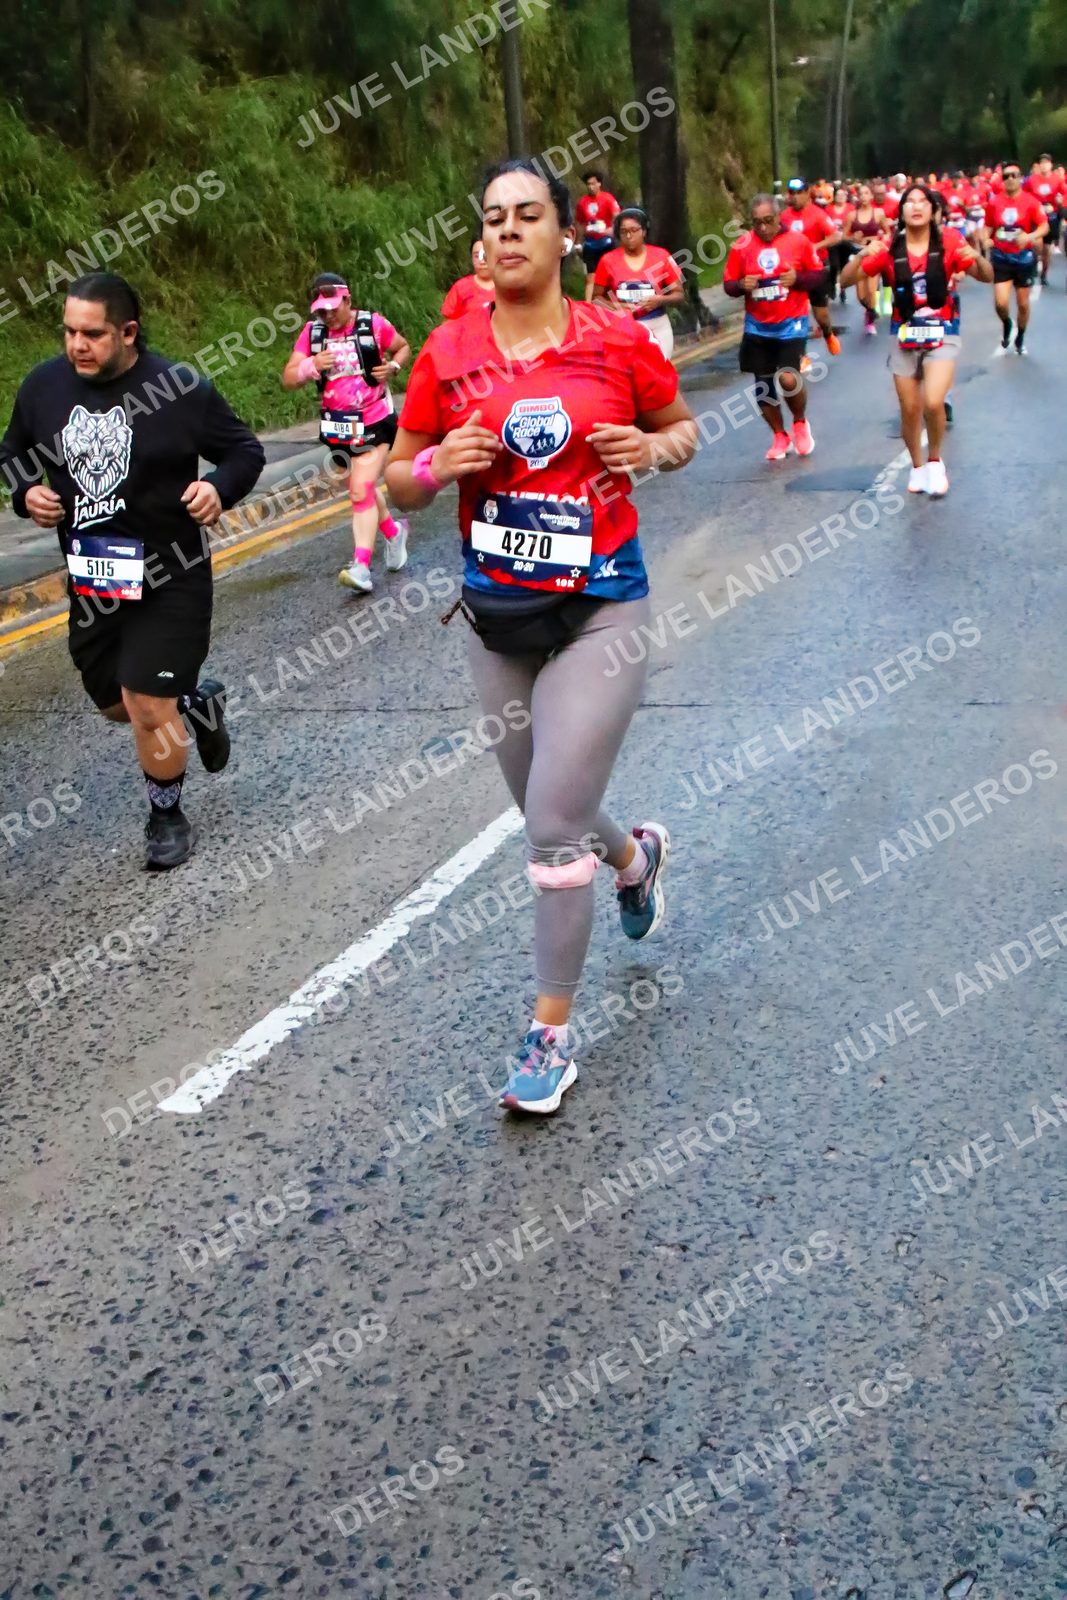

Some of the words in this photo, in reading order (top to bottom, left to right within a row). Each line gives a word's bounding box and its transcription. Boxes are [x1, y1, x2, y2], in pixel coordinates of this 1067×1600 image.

[519, 404, 555, 413] BIMBO
[520, 415, 555, 428] Global
[513, 427, 540, 438] Race
[75, 495, 89, 507] LA
[72, 494, 126, 528] JAURÍA
[501, 530, 552, 560] 4270
[87, 559, 114, 576] 5115
[555, 578, 575, 587] 10K
